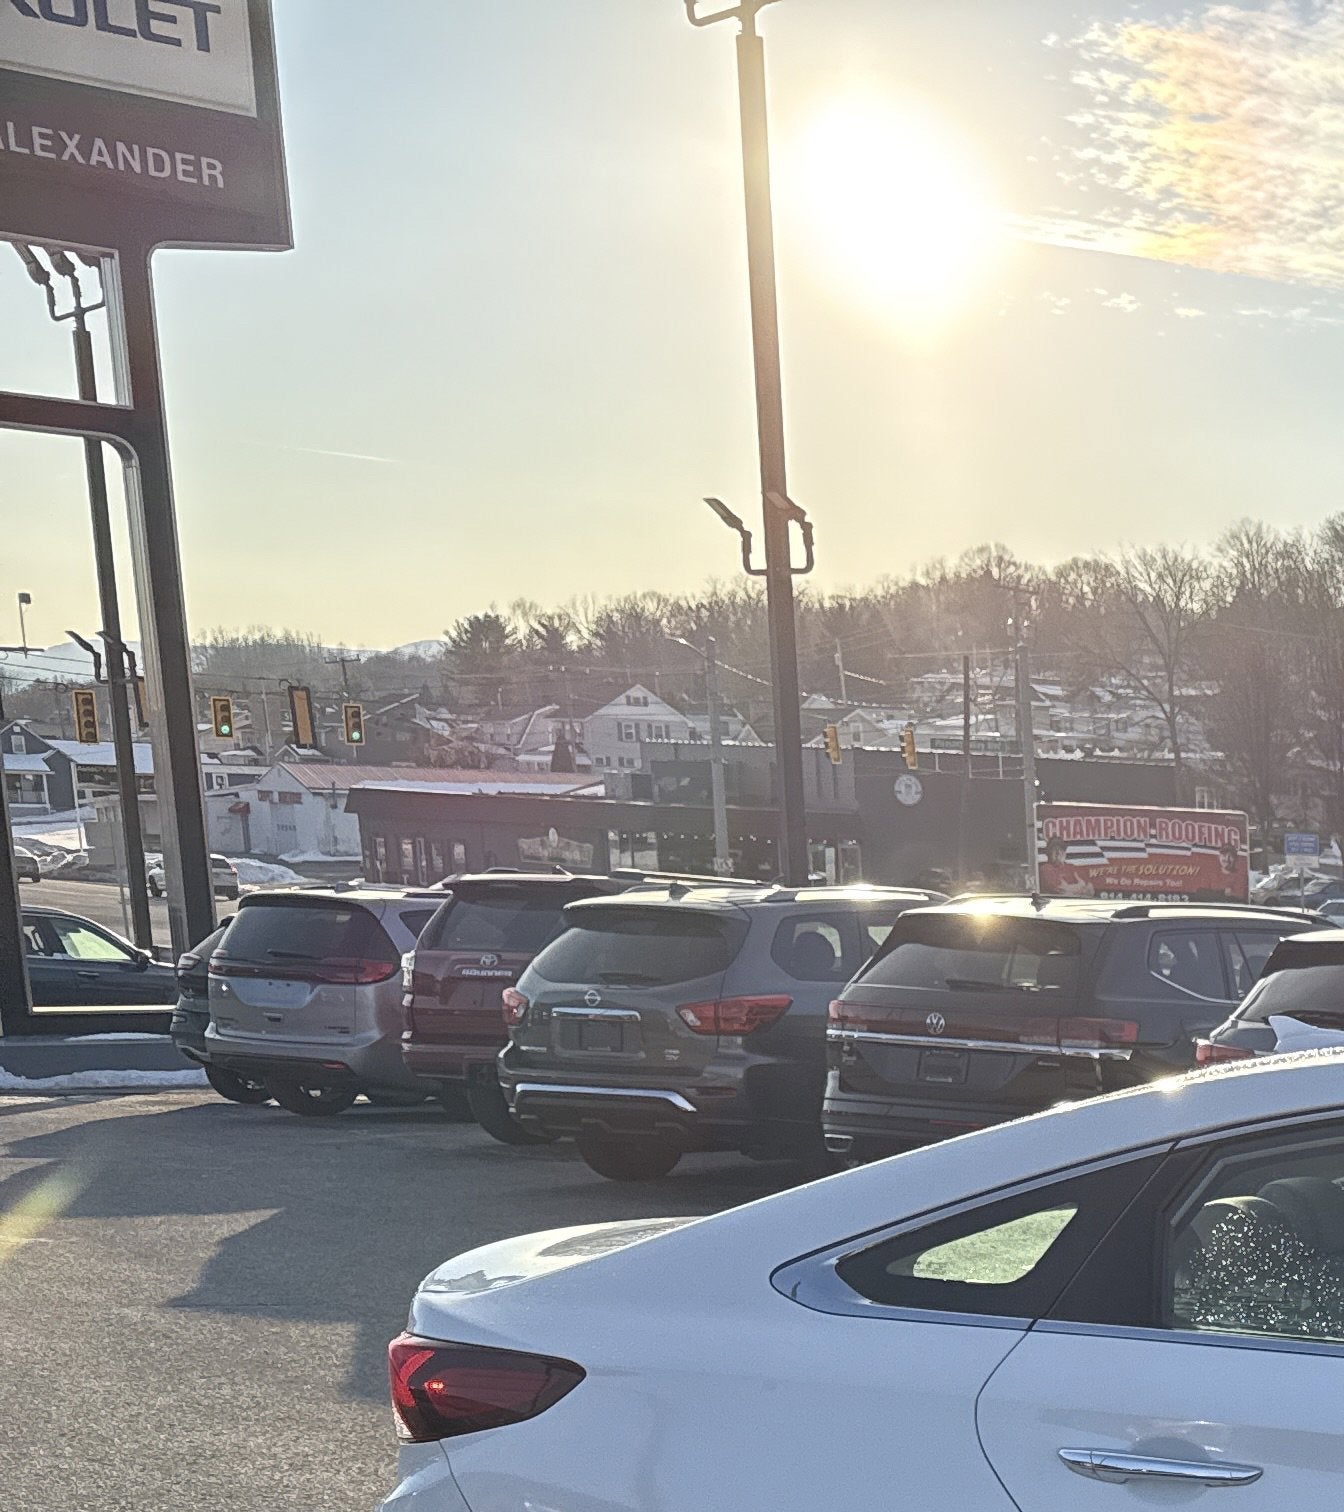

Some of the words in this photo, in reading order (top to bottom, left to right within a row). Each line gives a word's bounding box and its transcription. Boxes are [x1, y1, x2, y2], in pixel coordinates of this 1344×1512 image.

[0, 121, 224, 188] LEXANDER
[1043, 816, 1150, 842] CHAMPION
[1156, 818, 1241, 848] ROOFING
[1139, 864, 1200, 876] SOLUTION!
